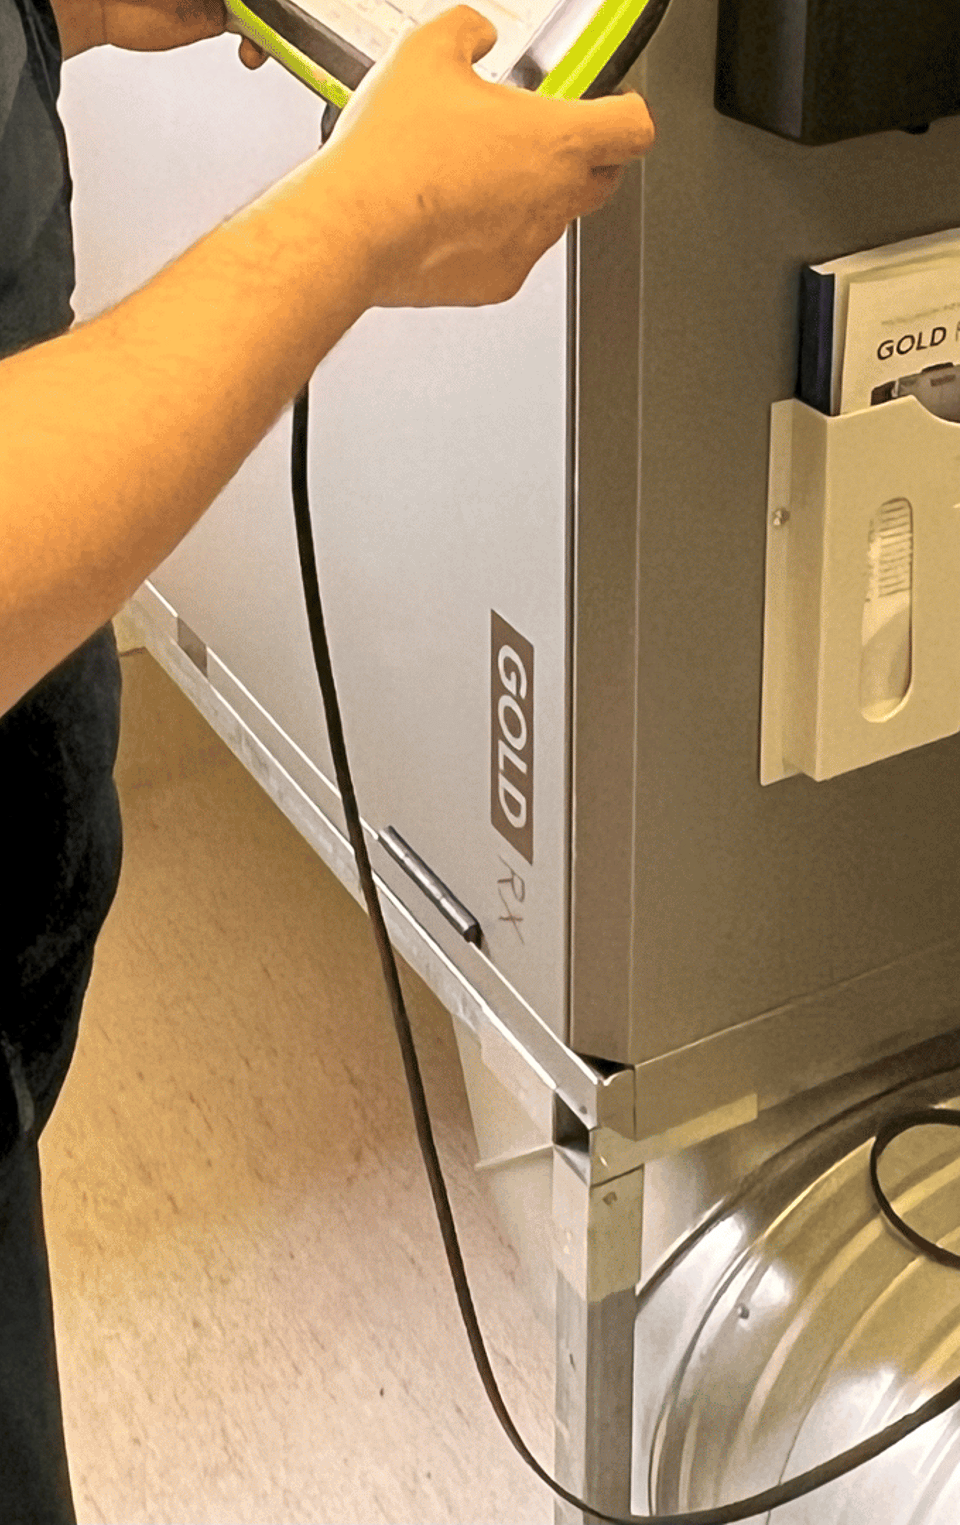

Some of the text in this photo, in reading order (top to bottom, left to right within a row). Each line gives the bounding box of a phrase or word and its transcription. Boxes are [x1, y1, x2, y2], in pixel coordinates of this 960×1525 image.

[877, 326, 947, 361] GOLD
[497, 644, 528, 946] GOLD RX
